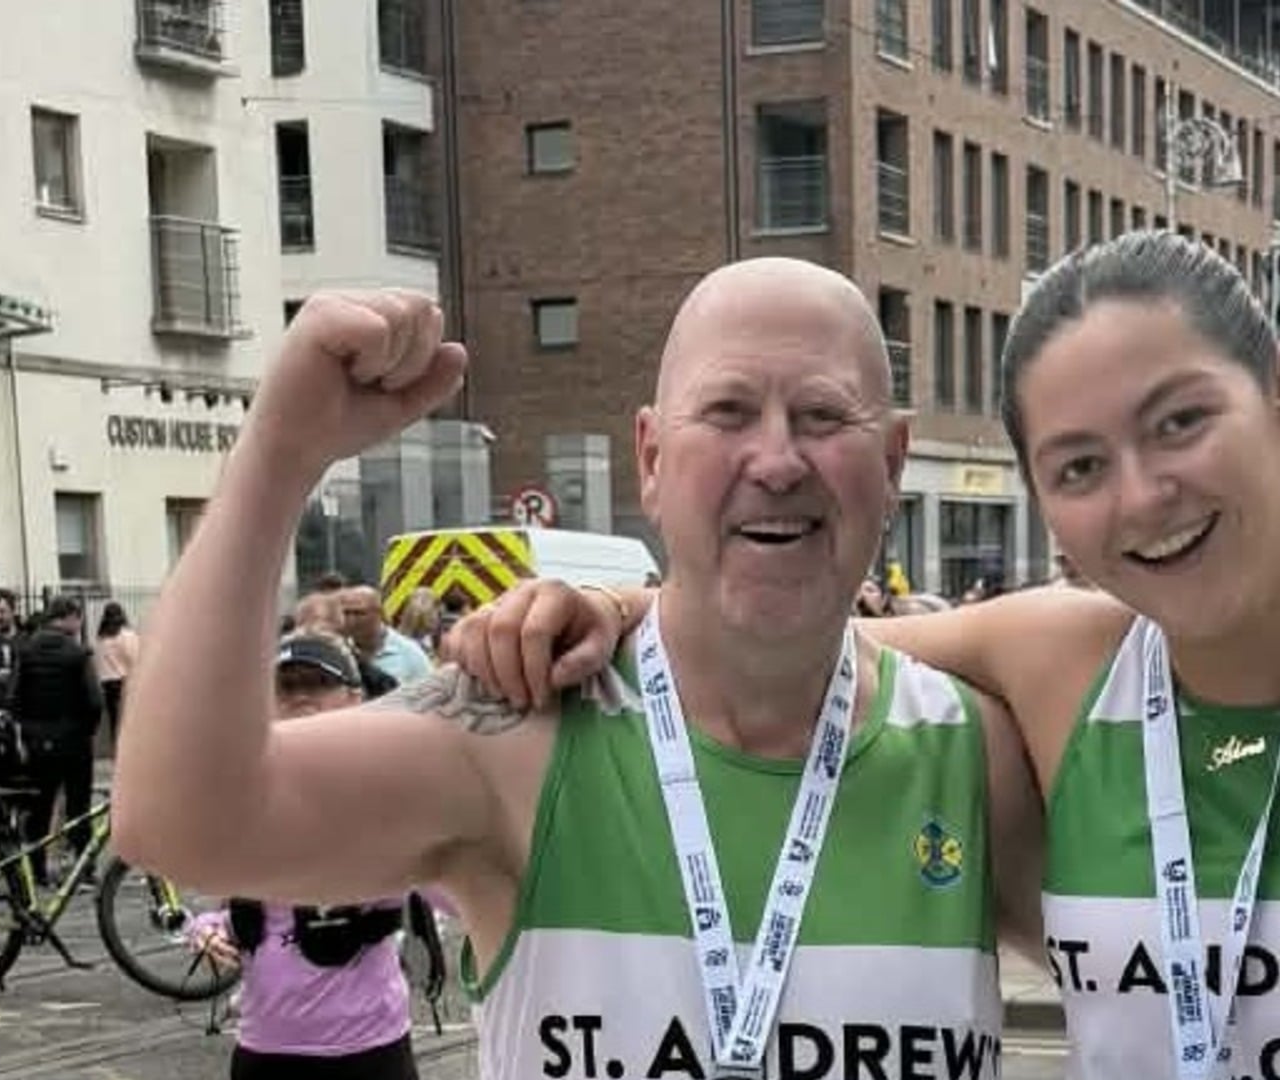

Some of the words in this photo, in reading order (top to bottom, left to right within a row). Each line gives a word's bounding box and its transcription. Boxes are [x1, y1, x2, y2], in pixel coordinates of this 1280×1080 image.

[107, 415, 167, 448] CUSTOM
[169, 419, 214, 452] HOUSE
[539, 1014, 625, 1080] ST.
